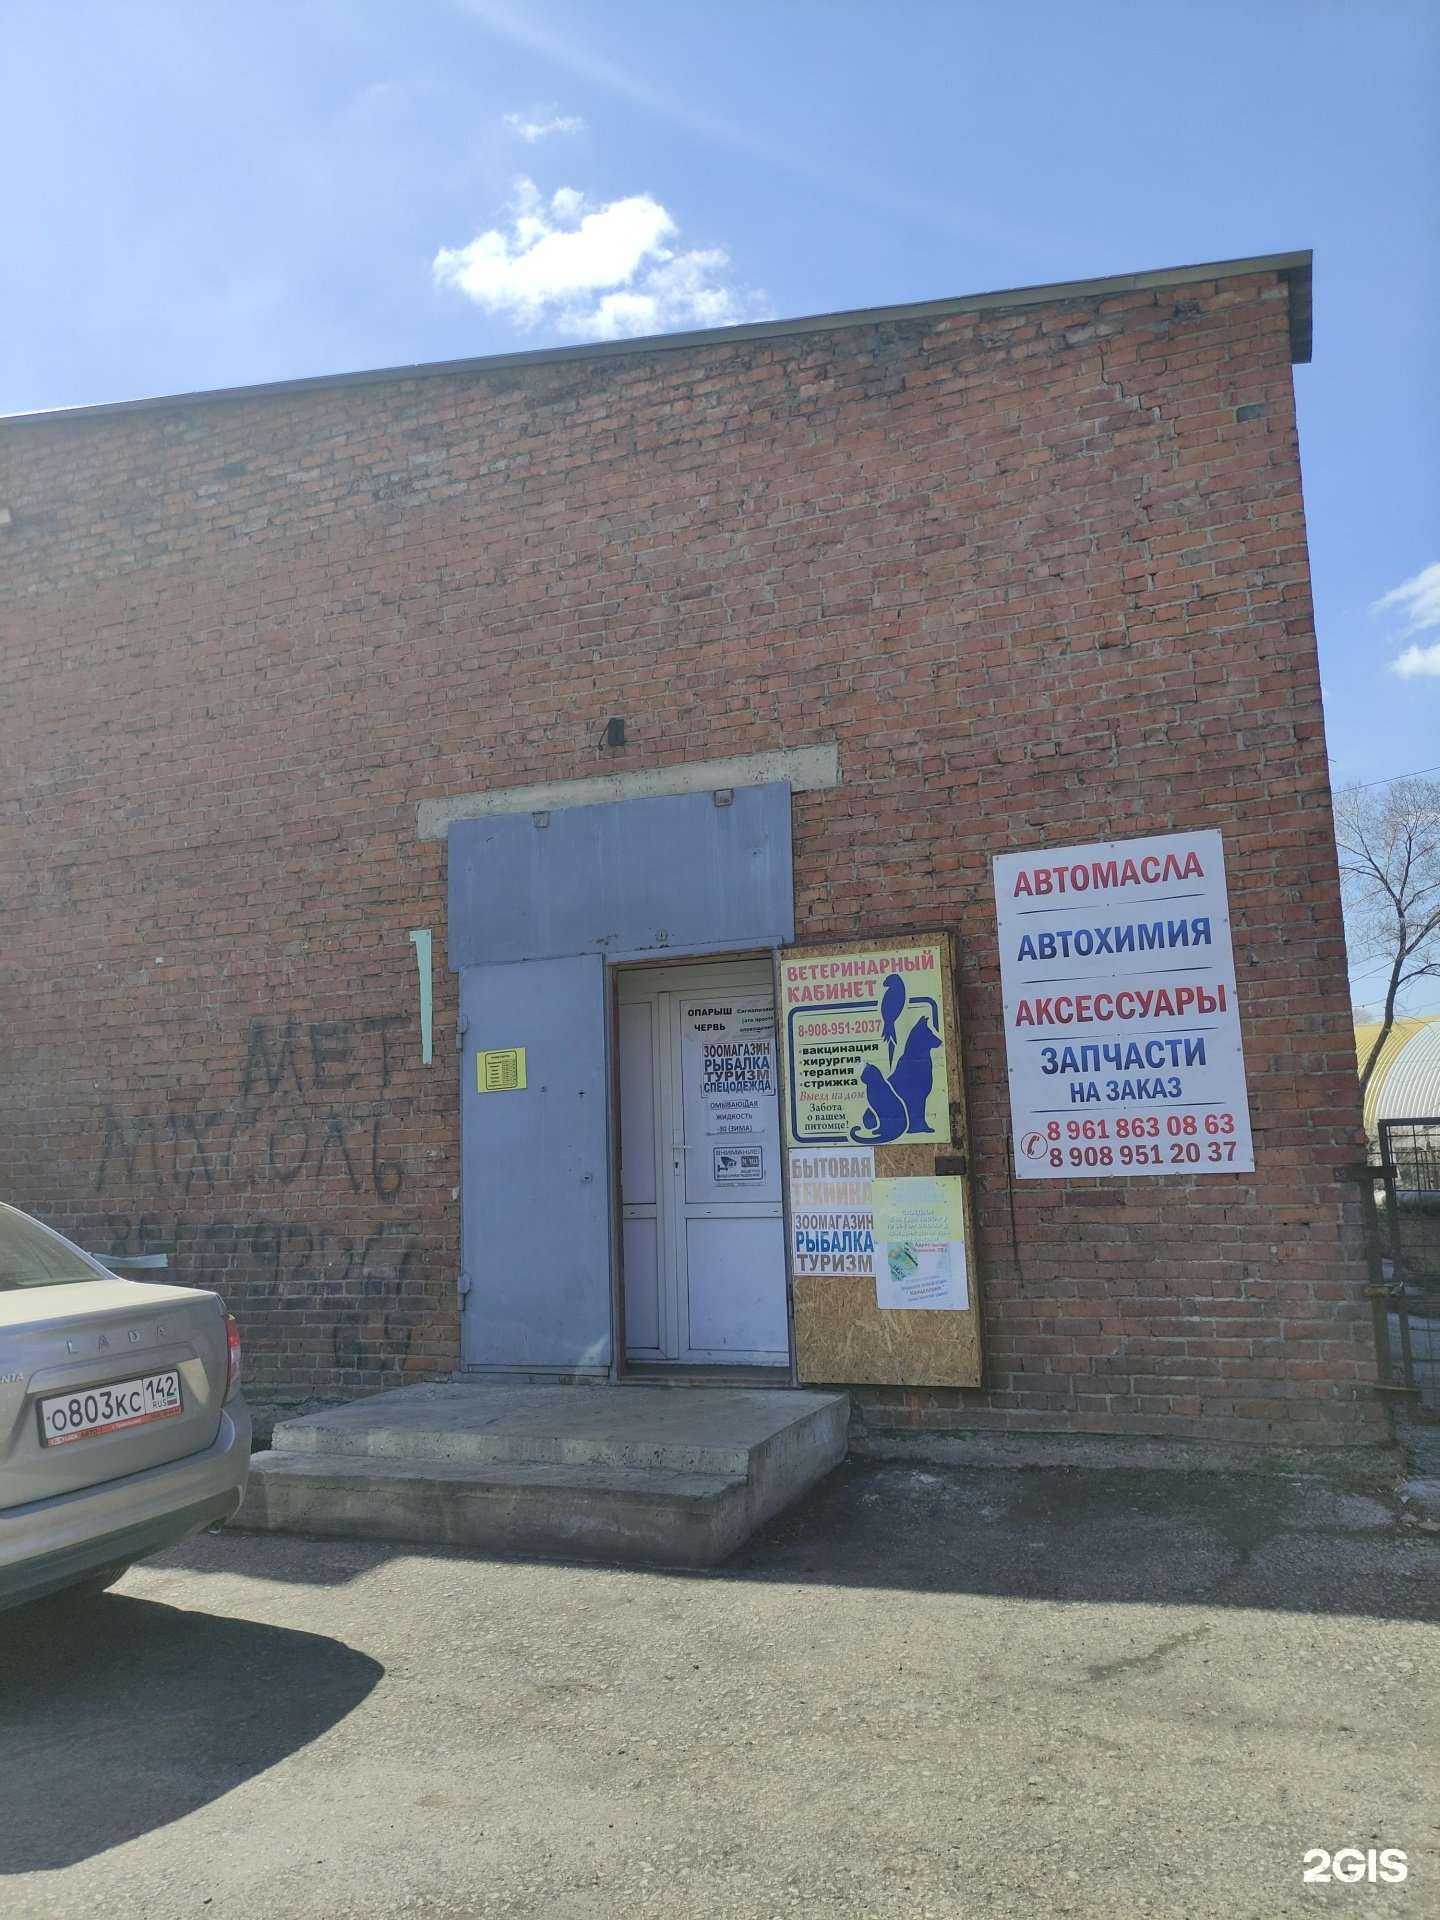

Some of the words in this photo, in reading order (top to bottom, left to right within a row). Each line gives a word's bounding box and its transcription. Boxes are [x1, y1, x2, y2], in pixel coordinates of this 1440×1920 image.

[1013, 852, 1204, 898] АВТОМАСЛА
[1017, 917, 1212, 962] АВТОХИМИЯ
[787, 951, 934, 981] ВЕТЕРИНАРНЫЙ
[787, 980, 876, 1003] КАБИНЕТ
[688, 1007, 732, 1017] ОПАРЫШ
[1015, 984, 1228, 1027] АКСЕССУАРЫ
[694, 1023, 726, 1032] ЧЕРВЬ
[798, 1020, 882, 1037] 8-908-951-2037
[704, 1043, 770, 1058] ЗООМАГАЗИН
[802, 1043, 879, 1055] вакцинация
[1040, 1037, 1207, 1075] ЗАПЧАСТИ
[704, 1056, 770, 1072] РЫБАЛКА
[803, 1056, 861, 1068] хирургия
[705, 1070, 769, 1083] ТУРИЗМ
[803, 1067, 854, 1079] терапия
[704, 1081, 771, 1094] СПЕЦОДЕЖДА
[803, 1078, 858, 1090] стрижка
[1070, 1081, 1100, 1104] НА
[1106, 1076, 1182, 1102] ЗАКАЗ
[809, 1102, 842, 1112] Забота
[815, 1112, 846, 1121] вашем
[805, 1120, 849, 1131] питомце!
[1047, 1121, 1061, 1141] 8
[1066, 1119, 1110, 1140] 961
[1116, 1117, 1160, 1139] 863
[1166, 1115, 1198, 1137] 08
[1204, 1113, 1235, 1135] 63
[1050, 1148, 1064, 1168] 8
[1069, 1146, 1114, 1167] 908
[1120, 1144, 1164, 1166] 951
[1171, 1142, 1201, 1164] 20
[1208, 1141, 1238, 1163] 37
[791, 1156, 871, 1178] БЫТОВАЯ
[795, 1214, 873, 1230] ЗООМАГАЗИН
[796, 1231, 874, 1252] РЫБАЛКА
[797, 1254, 872, 1272] ТУРИЗМ
[146, 1376, 175, 1401] 142
[152, 1400, 167, 1408] RUS
